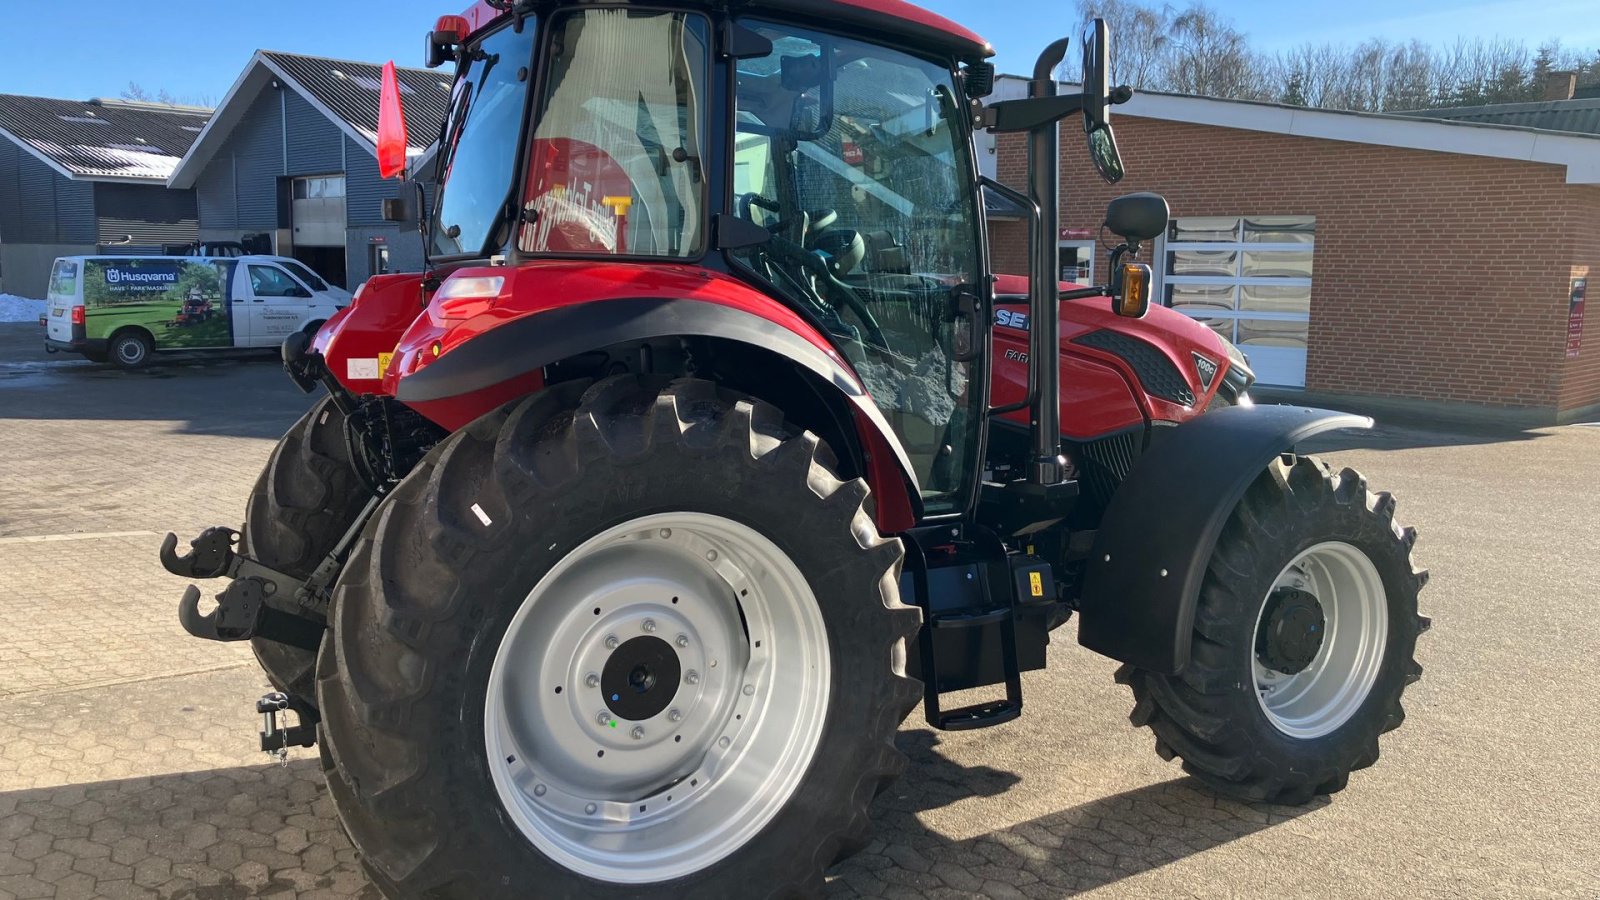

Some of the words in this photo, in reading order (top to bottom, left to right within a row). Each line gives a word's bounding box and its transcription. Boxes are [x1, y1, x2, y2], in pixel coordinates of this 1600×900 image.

[121, 272, 174, 282] Husqvarna
[996, 309, 1026, 328] SE
[1005, 349, 1029, 363] FAR
